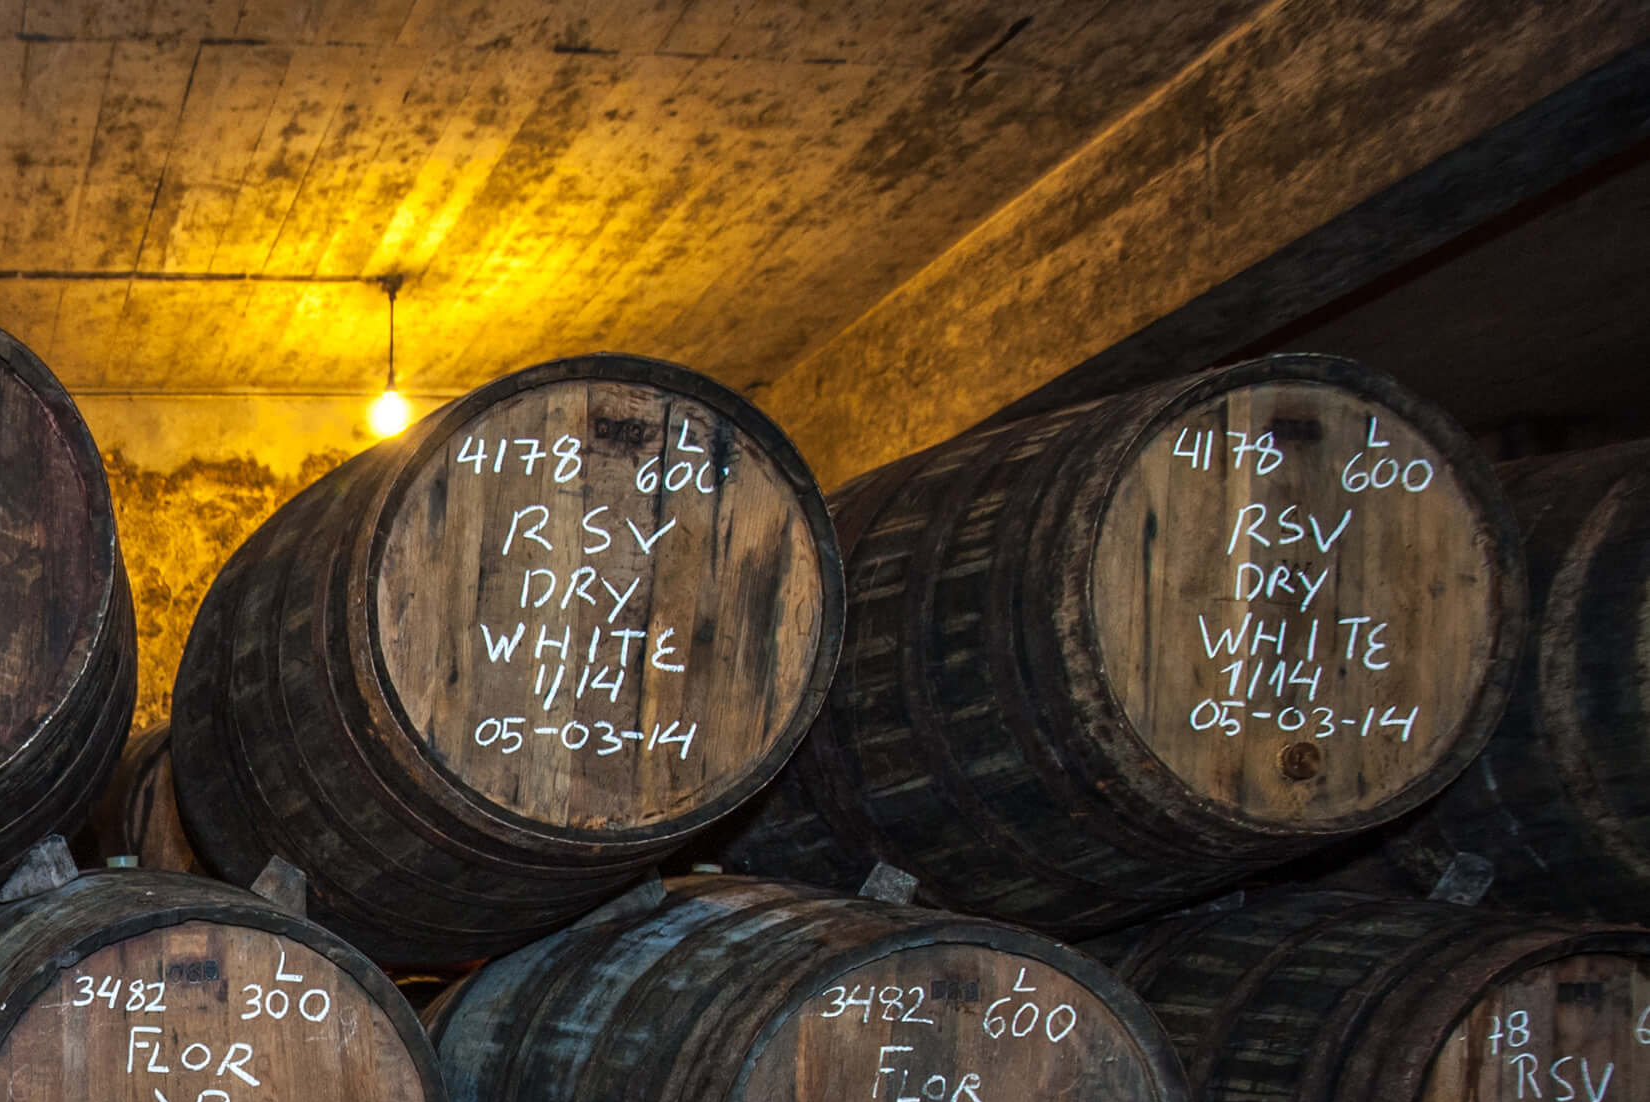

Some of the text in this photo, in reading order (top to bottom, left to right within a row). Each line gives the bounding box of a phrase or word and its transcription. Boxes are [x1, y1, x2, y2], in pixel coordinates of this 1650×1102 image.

[676, 418, 704, 453] L
[1367, 416, 1390, 448] L
[456, 434, 582, 483] 4178
[1172, 427, 1433, 492] 4178 600
[502, 505, 677, 555] RSV
[1227, 504, 1351, 556] RSV
[520, 566, 640, 623] DRY
[1235, 562, 1328, 613] DRY
[480, 622, 685, 673] WHITE
[1198, 611, 1391, 670] WHITE
[534, 664, 625, 710] 1/14
[1220, 660, 1322, 701] 1/14
[475, 717, 696, 760] 05-03-14
[1190, 698, 1418, 742] 05-03-14
[275, 951, 303, 983] L
[1013, 967, 1037, 992] L
[72, 975, 331, 1022] 3482 300
[820, 985, 934, 1024] 3482
[982, 996, 1077, 1042] 600
[126, 1026, 261, 1086] FLOR
